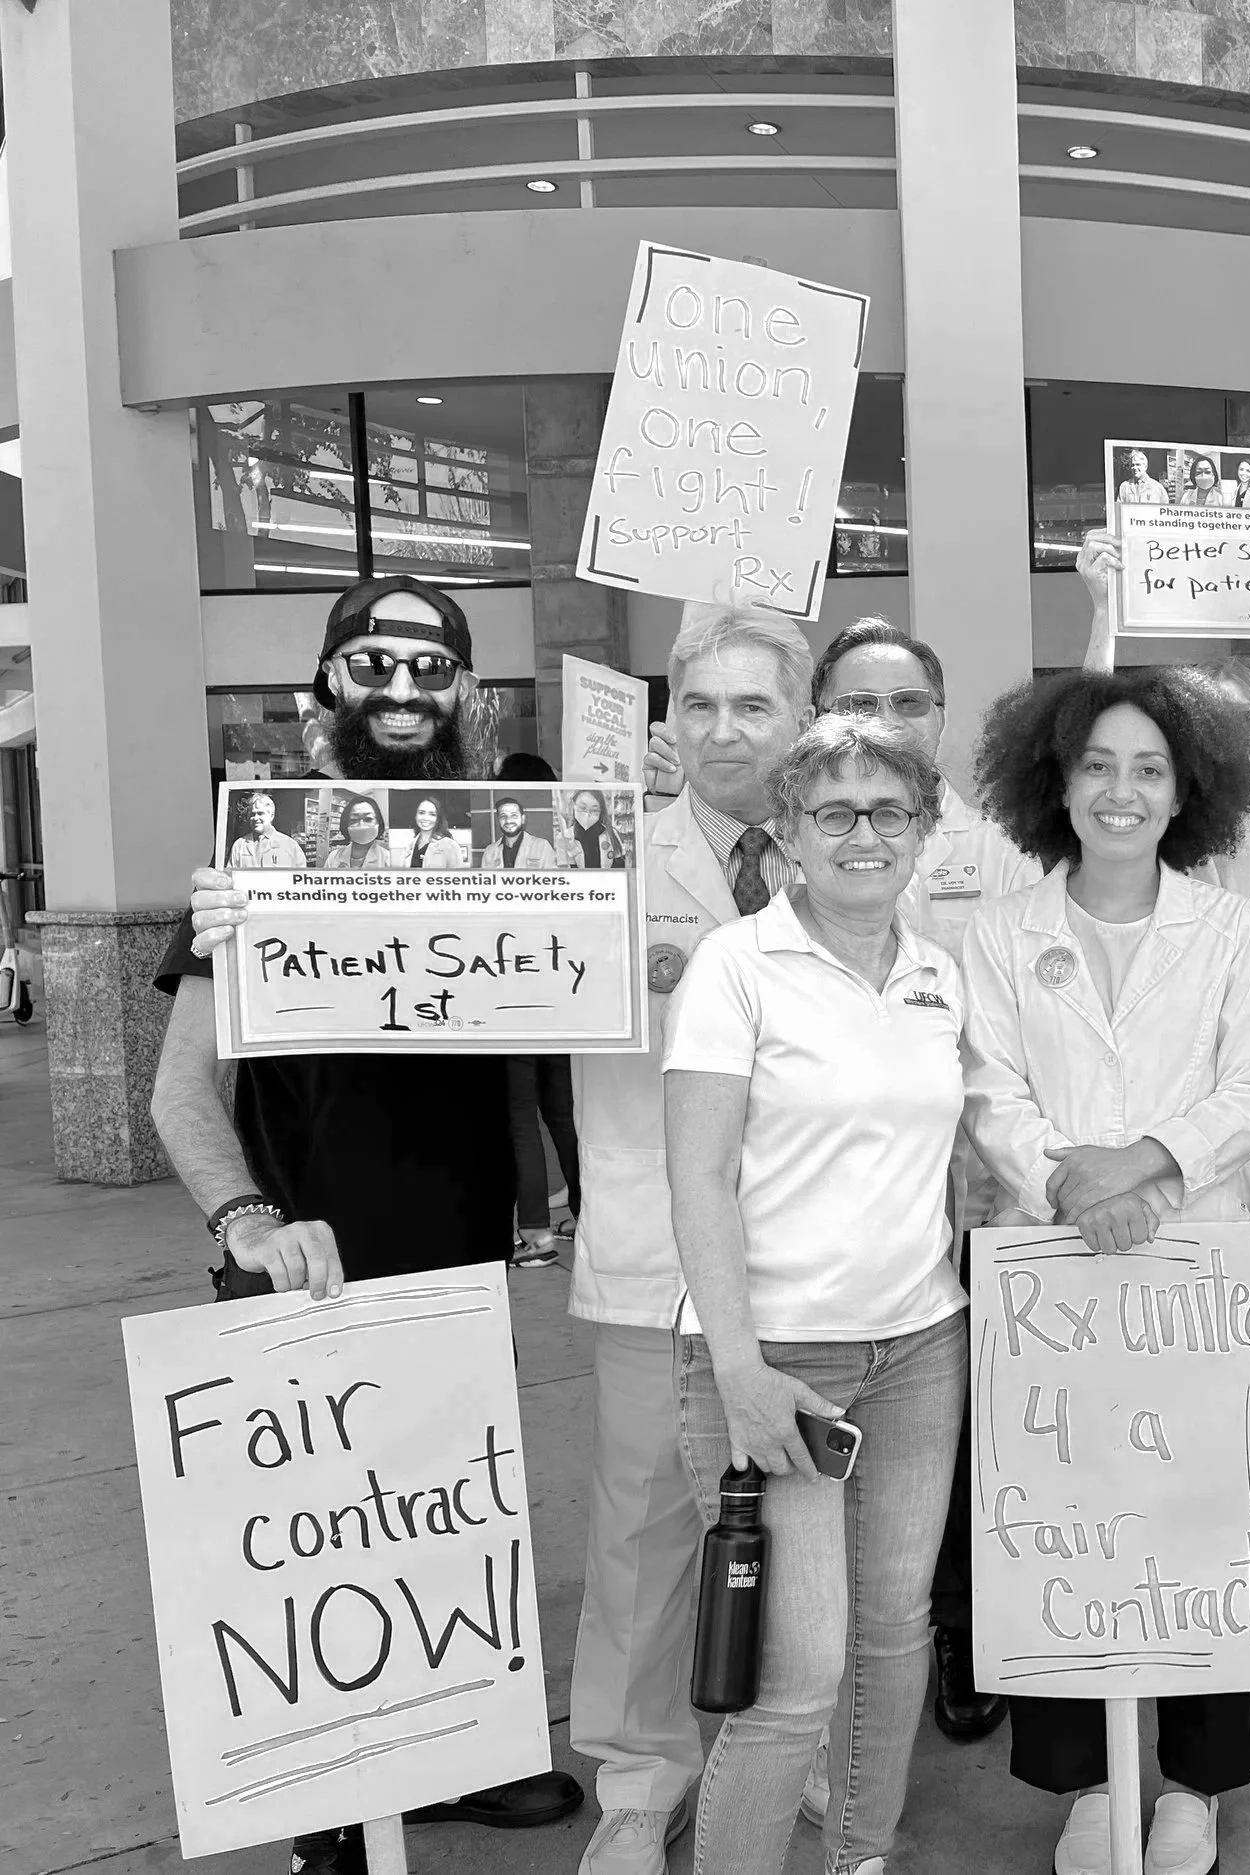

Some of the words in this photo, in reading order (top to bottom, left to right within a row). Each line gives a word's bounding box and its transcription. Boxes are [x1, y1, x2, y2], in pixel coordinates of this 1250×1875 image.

[1130, 518, 1146, 528] I'm
[1149, 519, 1195, 531] standing
[1197, 521, 1242, 533] together
[1159, 508, 1223, 519] Pharmacists
[1225, 512, 1242, 520] are
[1146, 540, 1230, 562] Better
[733, 557, 795, 596] Rx
[1139, 569, 1176, 594] for
[580, 676, 636, 706] SUPPORT
[292, 874, 392, 886] Pharmacists
[396, 876, 422, 886] are
[426, 874, 496, 886] essential
[501, 874, 570, 886] workers.
[248, 889, 272, 901] I'm
[277, 889, 347, 904] standing
[352, 889, 422, 904] together
[426, 889, 462, 901] with
[466, 891, 491, 904] my
[495, 889, 584, 901] co-workers
[588, 889, 616, 901] for:
[646, 912, 698, 924] harmacist
[380, 986, 455, 1031] 1st
[999, 1270, 1098, 1356] Rx
[164, 1376, 381, 1479] Fair
[1024, 1385, 1071, 1464] 4
[1129, 1410, 1172, 1461] a
[243, 1425, 518, 1571] contract
[985, 1485, 1147, 1560] fair
[727, 1574, 756, 1588] kanteen
[728, 1561, 748, 1575] klean
[212, 1539, 525, 1717] NOW!
